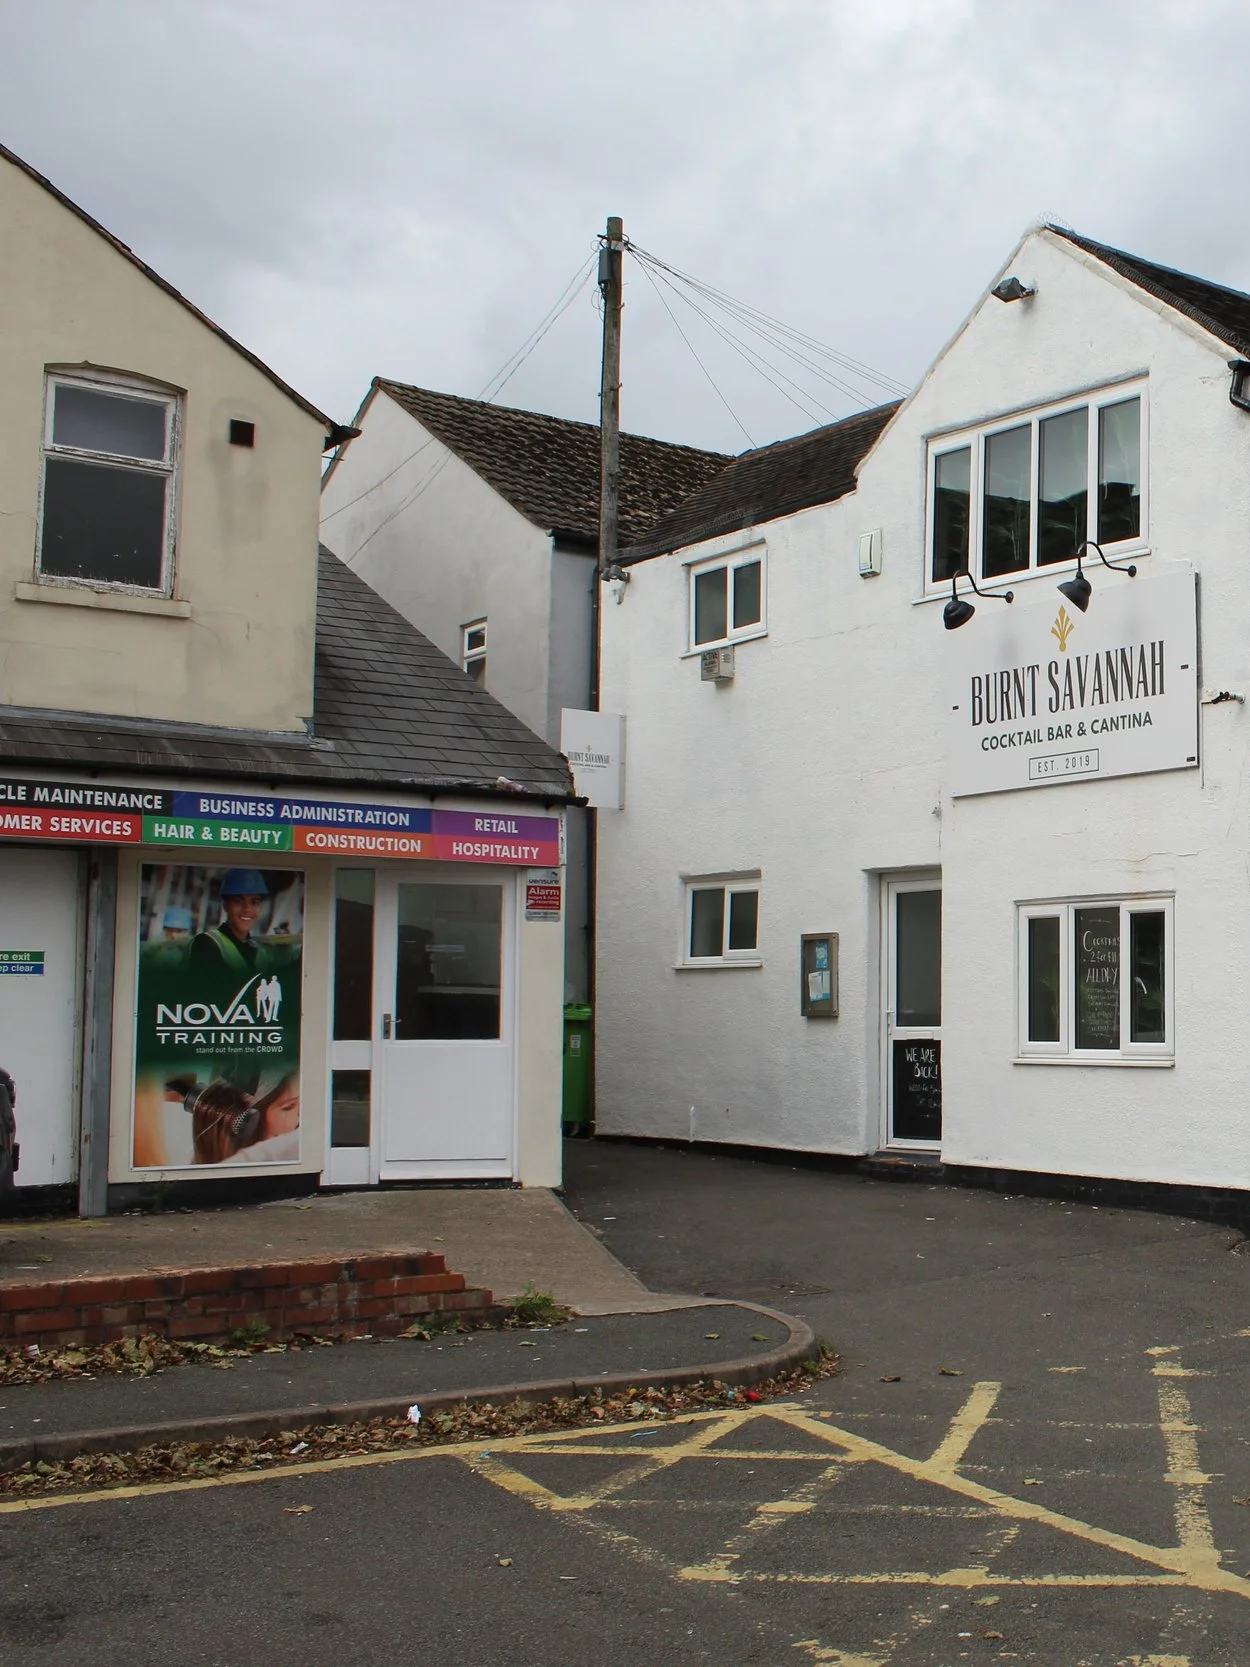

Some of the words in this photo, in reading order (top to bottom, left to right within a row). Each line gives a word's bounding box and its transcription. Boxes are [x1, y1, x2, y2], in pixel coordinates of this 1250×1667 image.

[971, 664, 1040, 727] BURNT
[1048, 640, 1165, 713] SAVANNAH
[981, 729, 1043, 751] COCKTAIL
[1047, 724, 1072, 741] BAR
[1077, 721, 1087, 736] &
[1090, 711, 1153, 734] CANTINA
[1038, 759, 1059, 773] EST.
[1065, 755, 1090, 769] 2019
[0, 784, 27, 800] CLE
[33, 787, 163, 810] MAINTENANCE
[200, 798, 275, 818] BUSINESS
[280, 803, 410, 827] ADMINISTRATION
[0, 814, 43, 831] MER
[49, 816, 132, 836] SERVICES
[154, 823, 195, 839] HAIR
[201, 826, 214, 841] &
[220, 827, 282, 844] BEAUTY
[475, 818, 518, 834] RETAIL
[306, 832, 421, 853] CONSTRUCTION
[452, 842, 539, 860] HOSPITALITY
[528, 887, 559, 896] Alarm
[12, 953, 31, 961] exit
[11, 964, 34, 972] clear
[156, 1003, 255, 1024] NOVA
[156, 1032, 282, 1044] TRAINING
[256, 1045, 283, 1053] CROWD
[905, 1047, 918, 1062] WE
